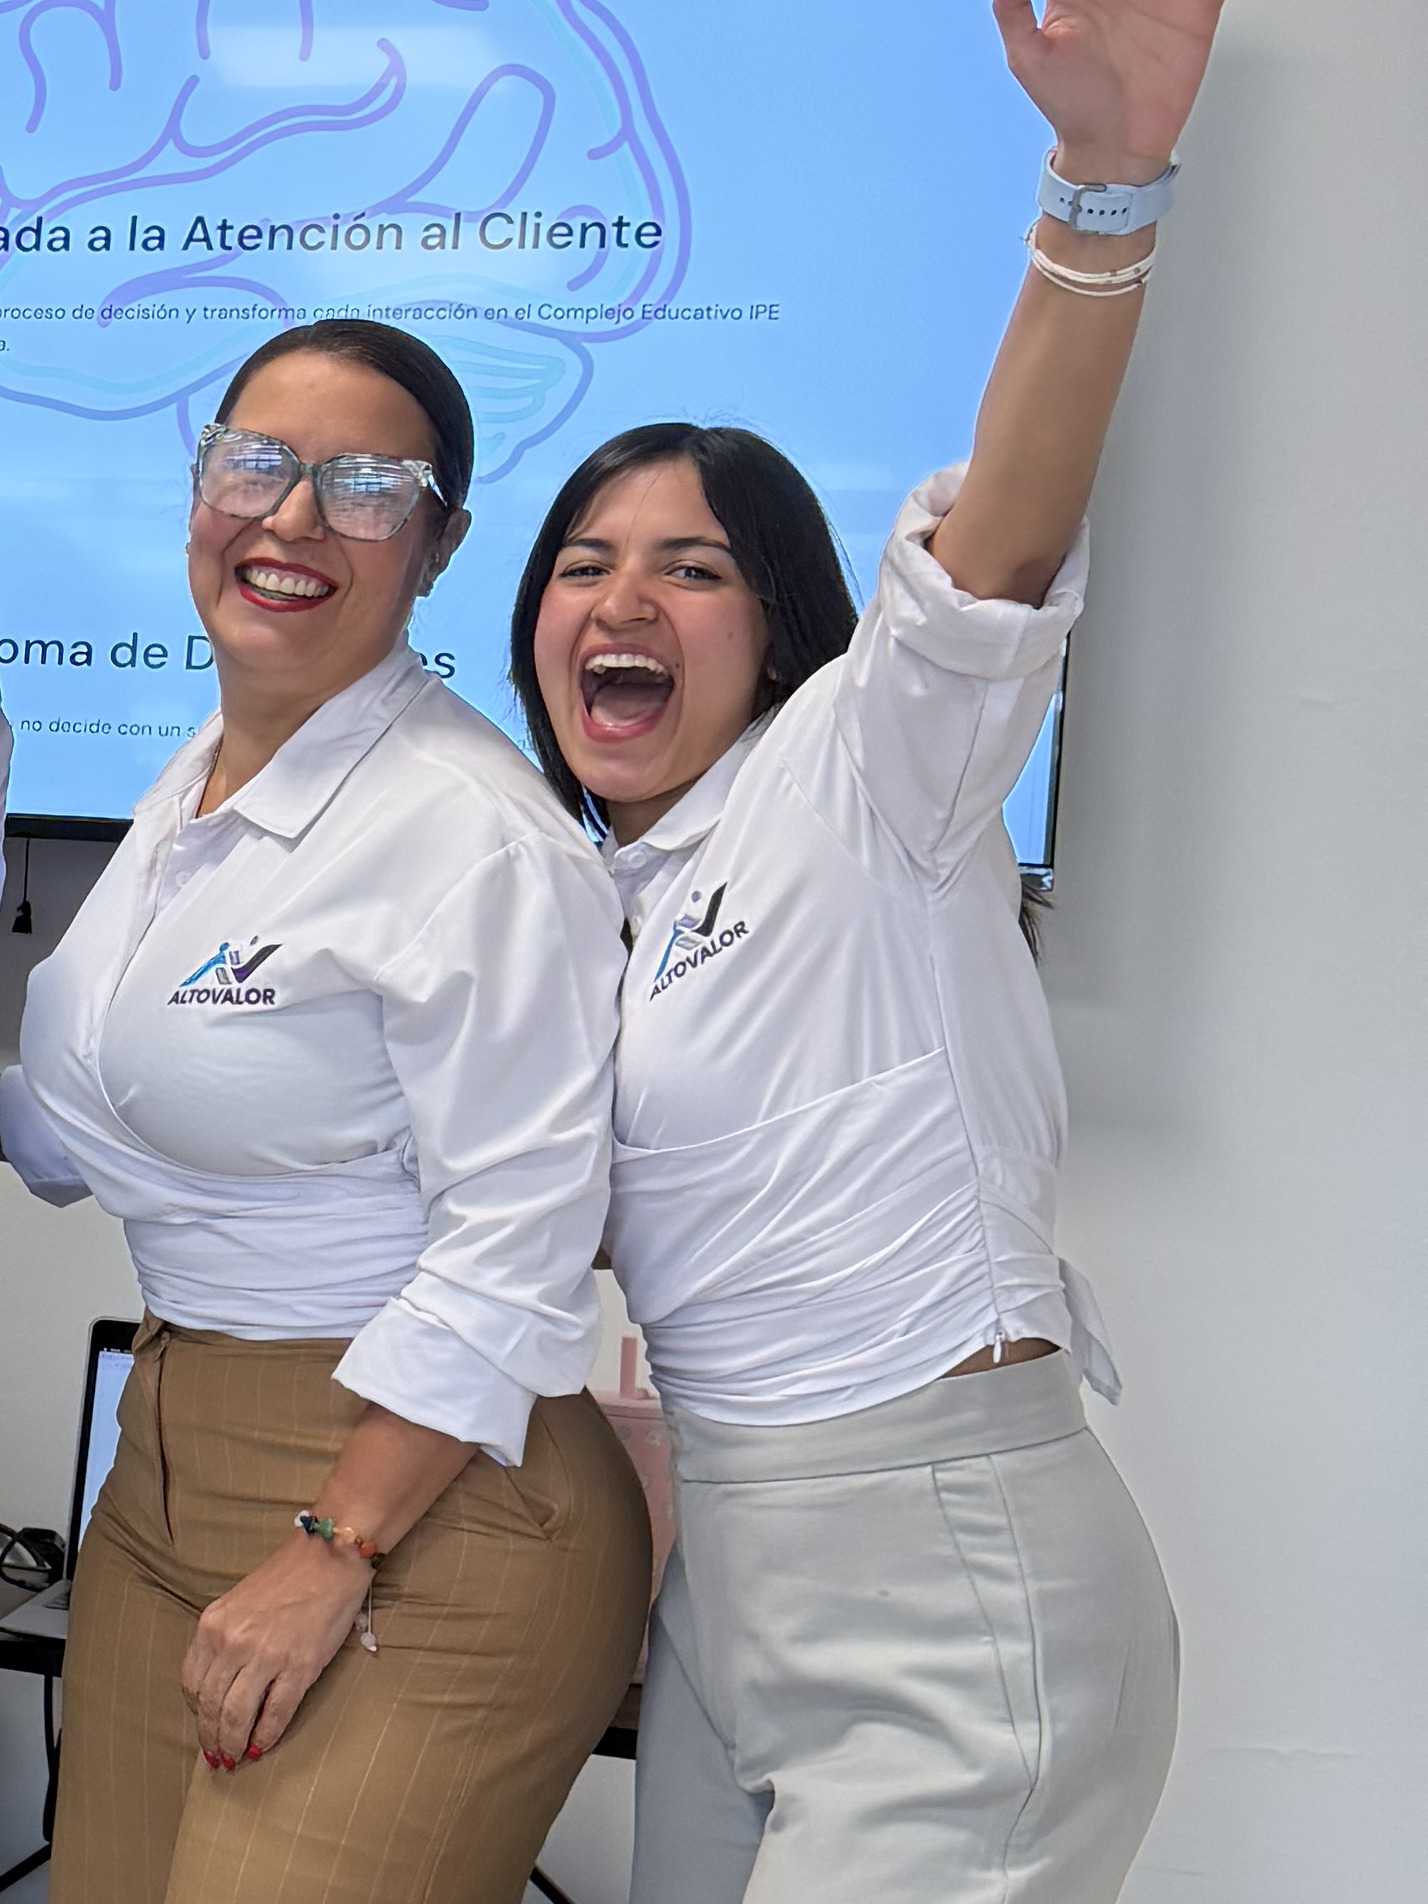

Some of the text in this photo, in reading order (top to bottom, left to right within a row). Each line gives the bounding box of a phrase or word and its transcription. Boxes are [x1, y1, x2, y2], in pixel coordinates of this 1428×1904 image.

[87, 223, 112, 253] a
[128, 214, 166, 253] la
[181, 210, 404, 252] Atención
[419, 211, 461, 252] al
[478, 210, 663, 251] Cliente
[71, 303, 96, 321] de
[100, 302, 179, 321] decisión
[185, 306, 197, 324] y
[202, 303, 307, 321] transforma
[367, 302, 478, 321] interacción
[484, 306, 508, 321] en
[514, 302, 532, 321] el
[537, 302, 636, 325] Complejo
[640, 303, 744, 321] Educativo
[748, 304, 781, 321] IPE
[108, 631, 170, 670] de
[117, 721, 152, 736] con
[157, 723, 183, 738] un
[650, 920, 750, 1002] ALTOVALOR
[166, 987, 276, 1006] ALTOVALOR
